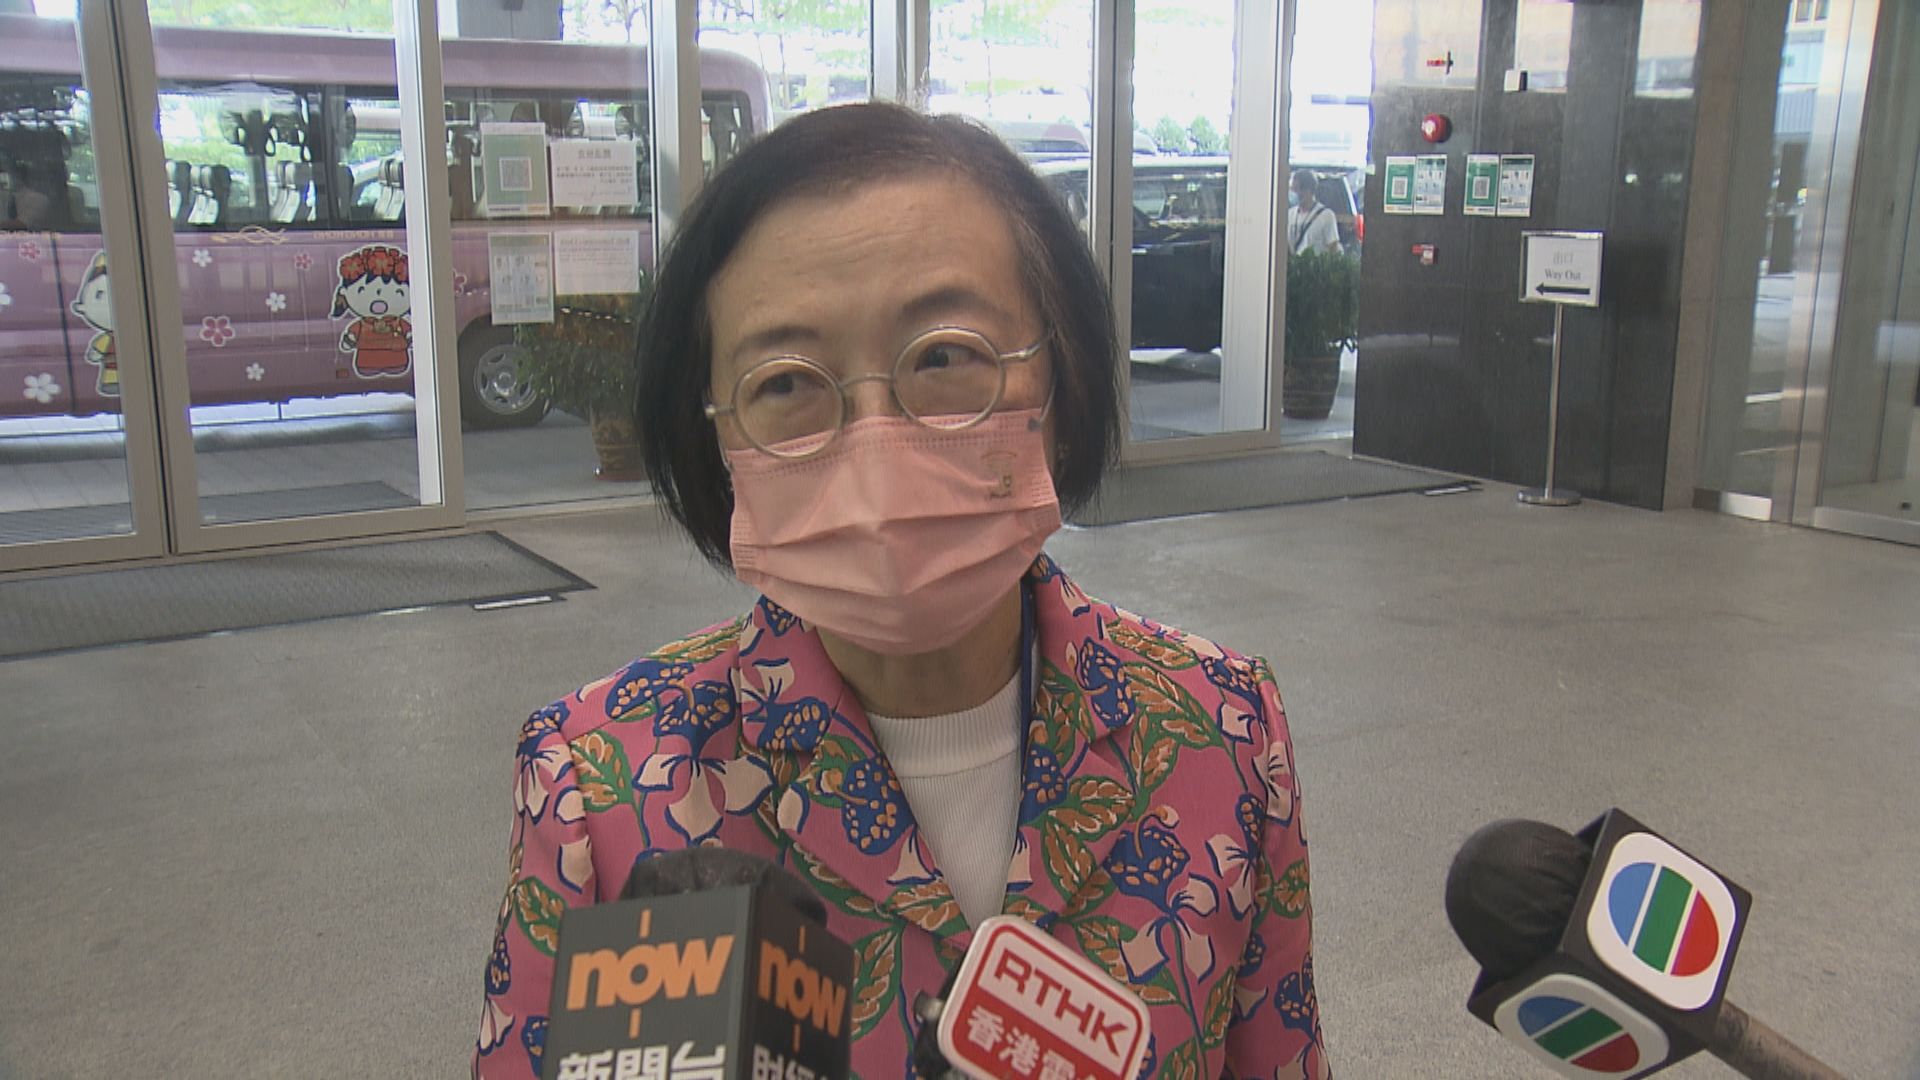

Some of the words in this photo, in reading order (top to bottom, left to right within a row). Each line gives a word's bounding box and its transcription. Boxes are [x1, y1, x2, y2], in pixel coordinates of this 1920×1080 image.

[1544, 268, 1563, 281] Way
[1565, 269, 1581, 281] Out
[566, 934, 735, 1010] now
[757, 939, 847, 1038] now
[994, 947, 1128, 1057] RTHK
[967, 1005, 1097, 1080] 香港電
